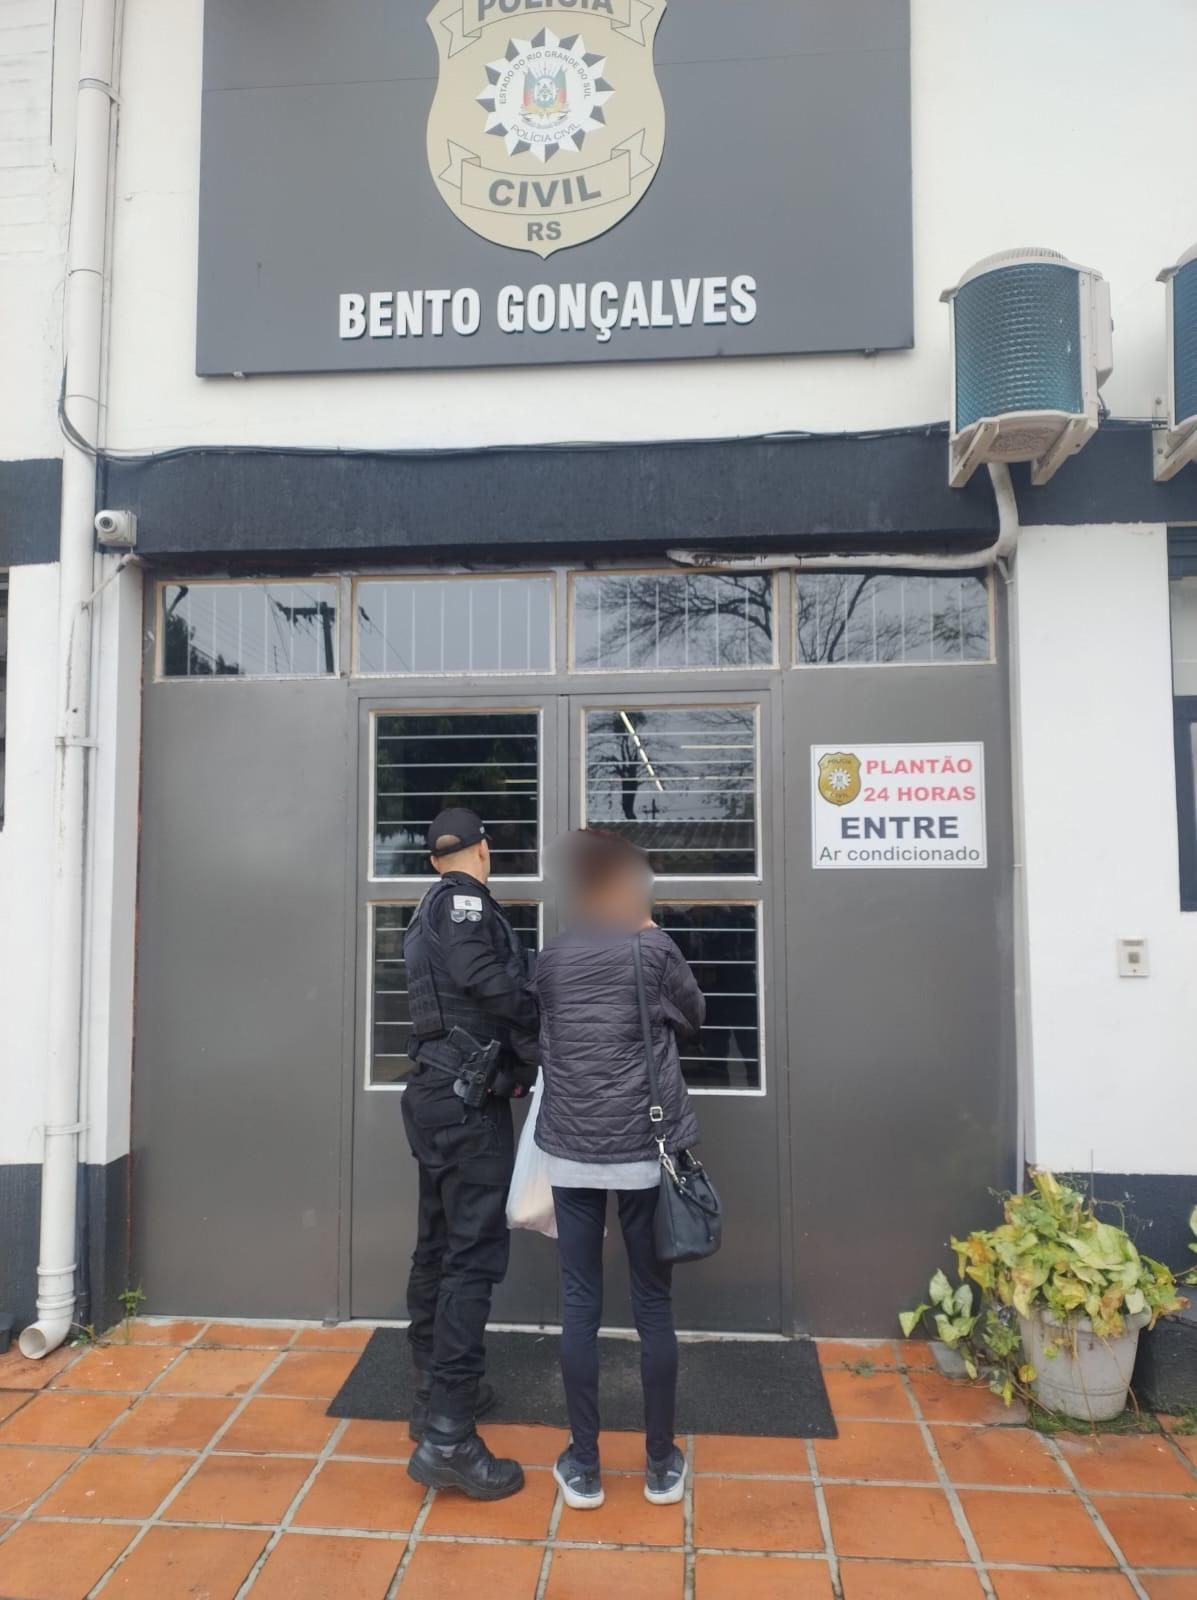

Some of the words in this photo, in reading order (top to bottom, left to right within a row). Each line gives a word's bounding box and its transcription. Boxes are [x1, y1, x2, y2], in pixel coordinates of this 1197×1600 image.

[499, 70, 514, 105] ESTADO
[513, 59, 525, 71] DO
[527, 51, 542, 62] RIO
[544, 50, 579, 68] GRANDE
[577, 67, 588, 80] DO
[583, 82, 592, 99] SUL
[553, 122, 579, 141] CIVIL
[488, 175, 602, 208] CIVIL
[527, 221, 562, 241] RS
[339, 287, 481, 339] BENTO
[497, 275, 757, 342] GONÇALVES
[866, 756, 973, 774] PLANTÃO
[864, 787, 890, 802] 24
[898, 786, 976, 802] HORAS
[841, 816, 959, 839] ENTRE
[819, 846, 841, 861] Ar
[847, 845, 980, 861] condicionado
